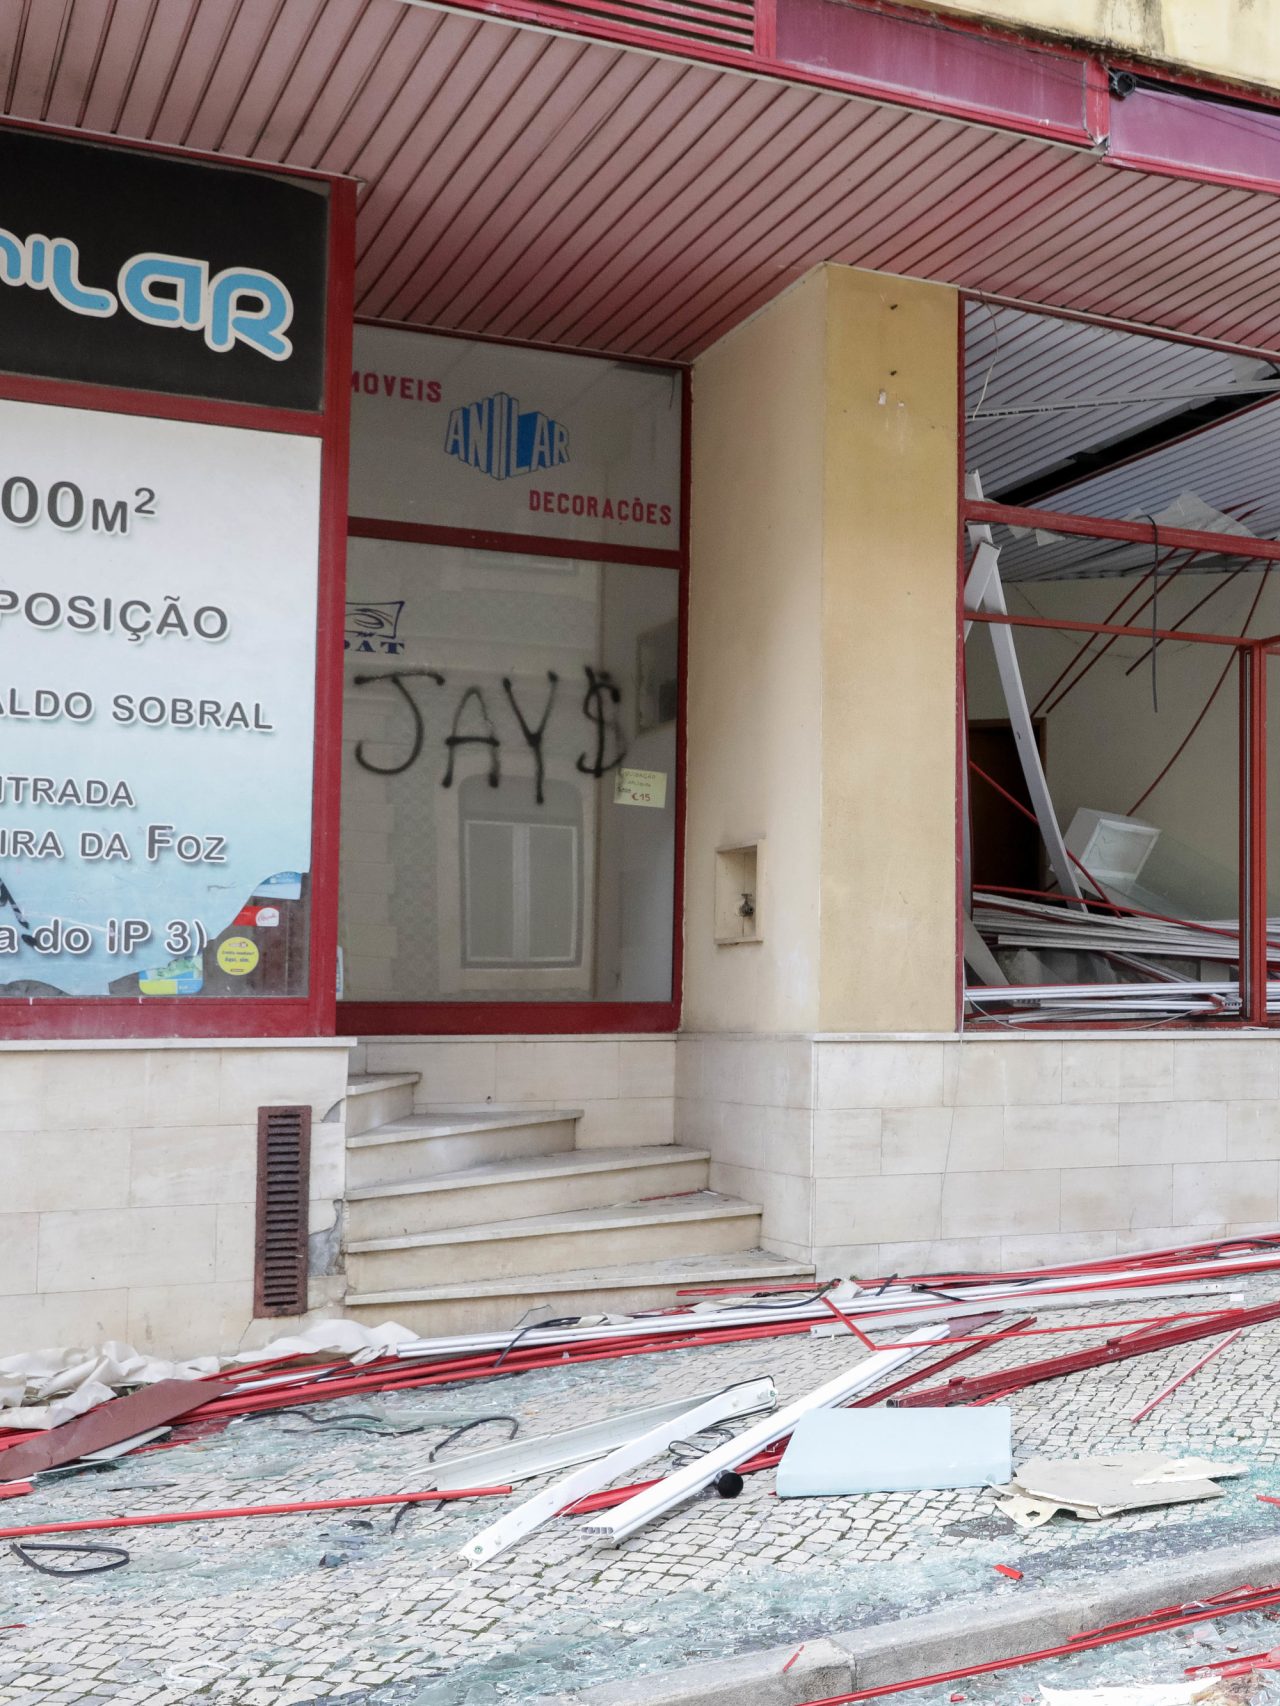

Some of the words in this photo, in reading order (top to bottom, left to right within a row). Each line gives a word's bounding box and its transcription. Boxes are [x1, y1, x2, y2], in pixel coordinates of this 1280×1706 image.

[444, 391, 570, 481] ANILAR
[0, 688, 93, 720] LDO
[112, 694, 273, 730] SOBRAL
[0, 776, 134, 806] TRADA
[80, 832, 129, 859] DA
[35, 919, 90, 952] do
[108, 919, 151, 953] IP
